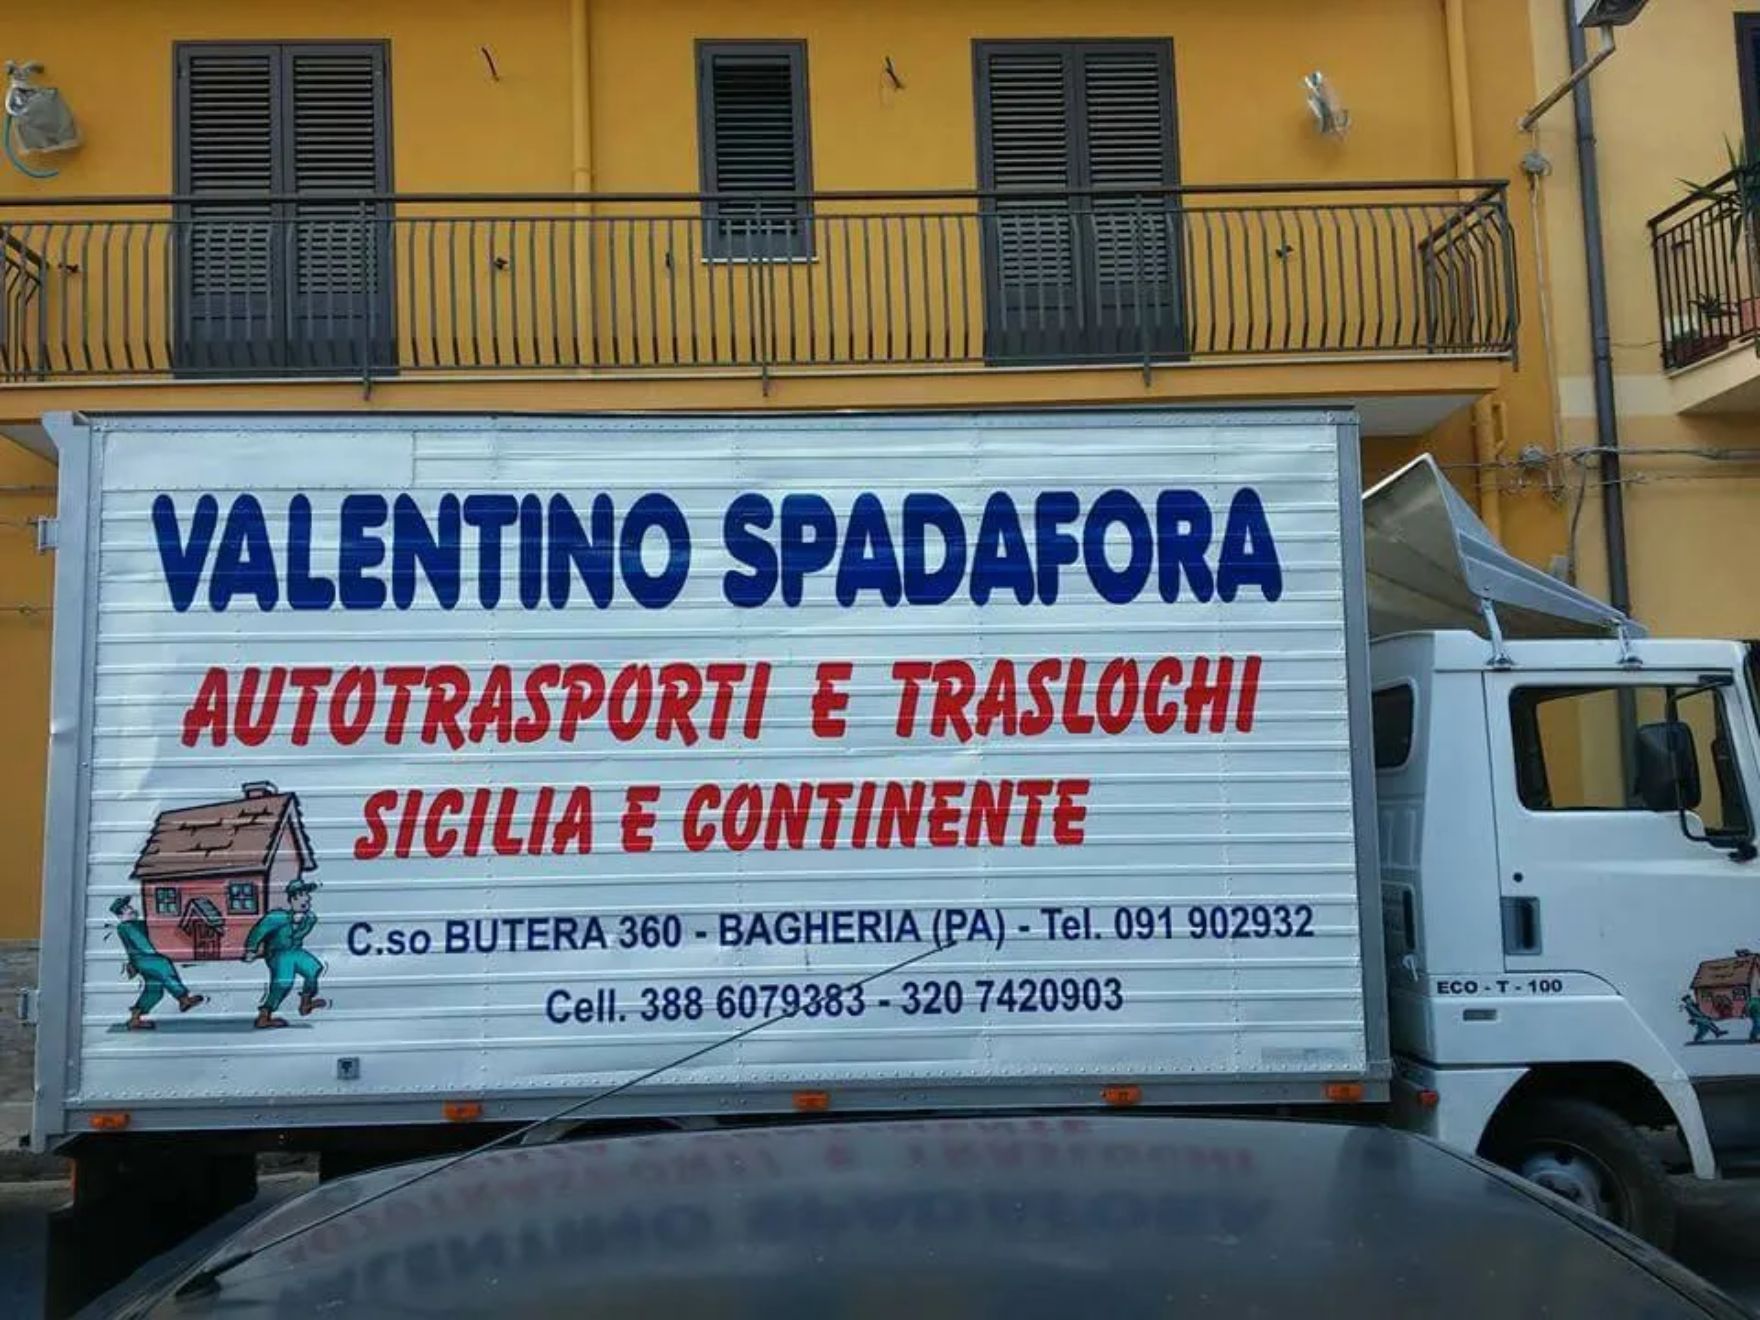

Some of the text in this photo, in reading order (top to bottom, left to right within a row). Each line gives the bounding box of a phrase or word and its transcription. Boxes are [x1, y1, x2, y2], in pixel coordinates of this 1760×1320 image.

[151, 488, 1283, 613] VALENTINO SPADAFORA
[182, 656, 1262, 749] AUTOTRASPORTI E TRASLOCHI
[354, 780, 1089, 859] SICILIA E CONTINENTE
[346, 921, 432, 956] C.so
[444, 915, 608, 954] BUTERA
[618, 913, 683, 950] 360
[718, 908, 924, 947] BAGHERIA
[931, 907, 1006, 951] (PA)
[1040, 907, 1102, 941] Tel.
[1114, 905, 1173, 941] 091
[1187, 903, 1316, 940] 902932
[545, 988, 626, 1025] Cell.
[639, 985, 704, 1022] 388
[715, 982, 867, 1021] 6079383
[900, 979, 965, 1017] 320
[974, 976, 1125, 1014] 7420903
[1436, 980, 1478, 995] ECO
[1495, 980, 1510, 994] T
[1528, 979, 1564, 994] 100
